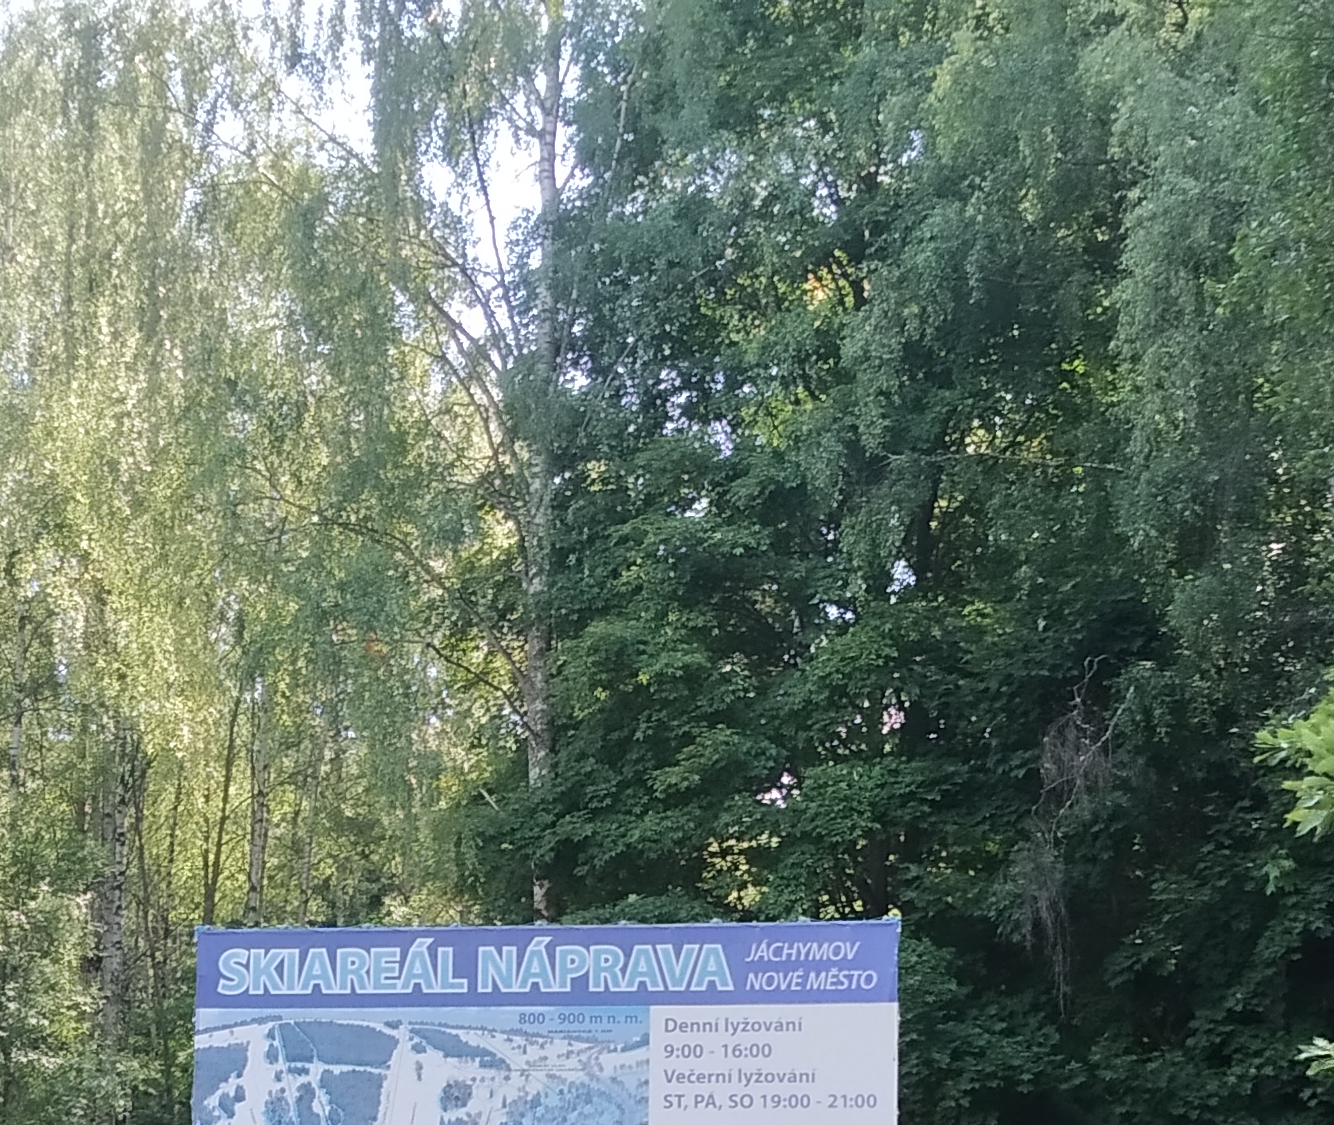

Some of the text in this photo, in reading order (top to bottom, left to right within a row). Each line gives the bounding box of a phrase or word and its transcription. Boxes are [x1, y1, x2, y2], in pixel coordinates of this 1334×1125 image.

[745, 939, 860, 961] JÁCHYMOV
[217, 937, 734, 995] SKIAREÁL NÁPRAVA
[746, 968, 878, 991] NOVÉ MĚSTO
[518, 1012, 546, 1025] 800
[557, 1012, 586, 1025] 900
[589, 1014, 603, 1025] m
[607, 1014, 621, 1025] n.
[624, 1014, 643, 1025] m.
[664, 1017, 804, 1036] Denní lyžování
[663, 1043, 704, 1059] 9:00
[721, 1043, 772, 1059] 16:00
[663, 1067, 817, 1087] Večerní lyžování
[663, 1094, 689, 1111] ST,
[728, 1093, 754, 1109] SO
[760, 1093, 811, 1109] 19:00
[827, 1093, 878, 1109] 21:00
